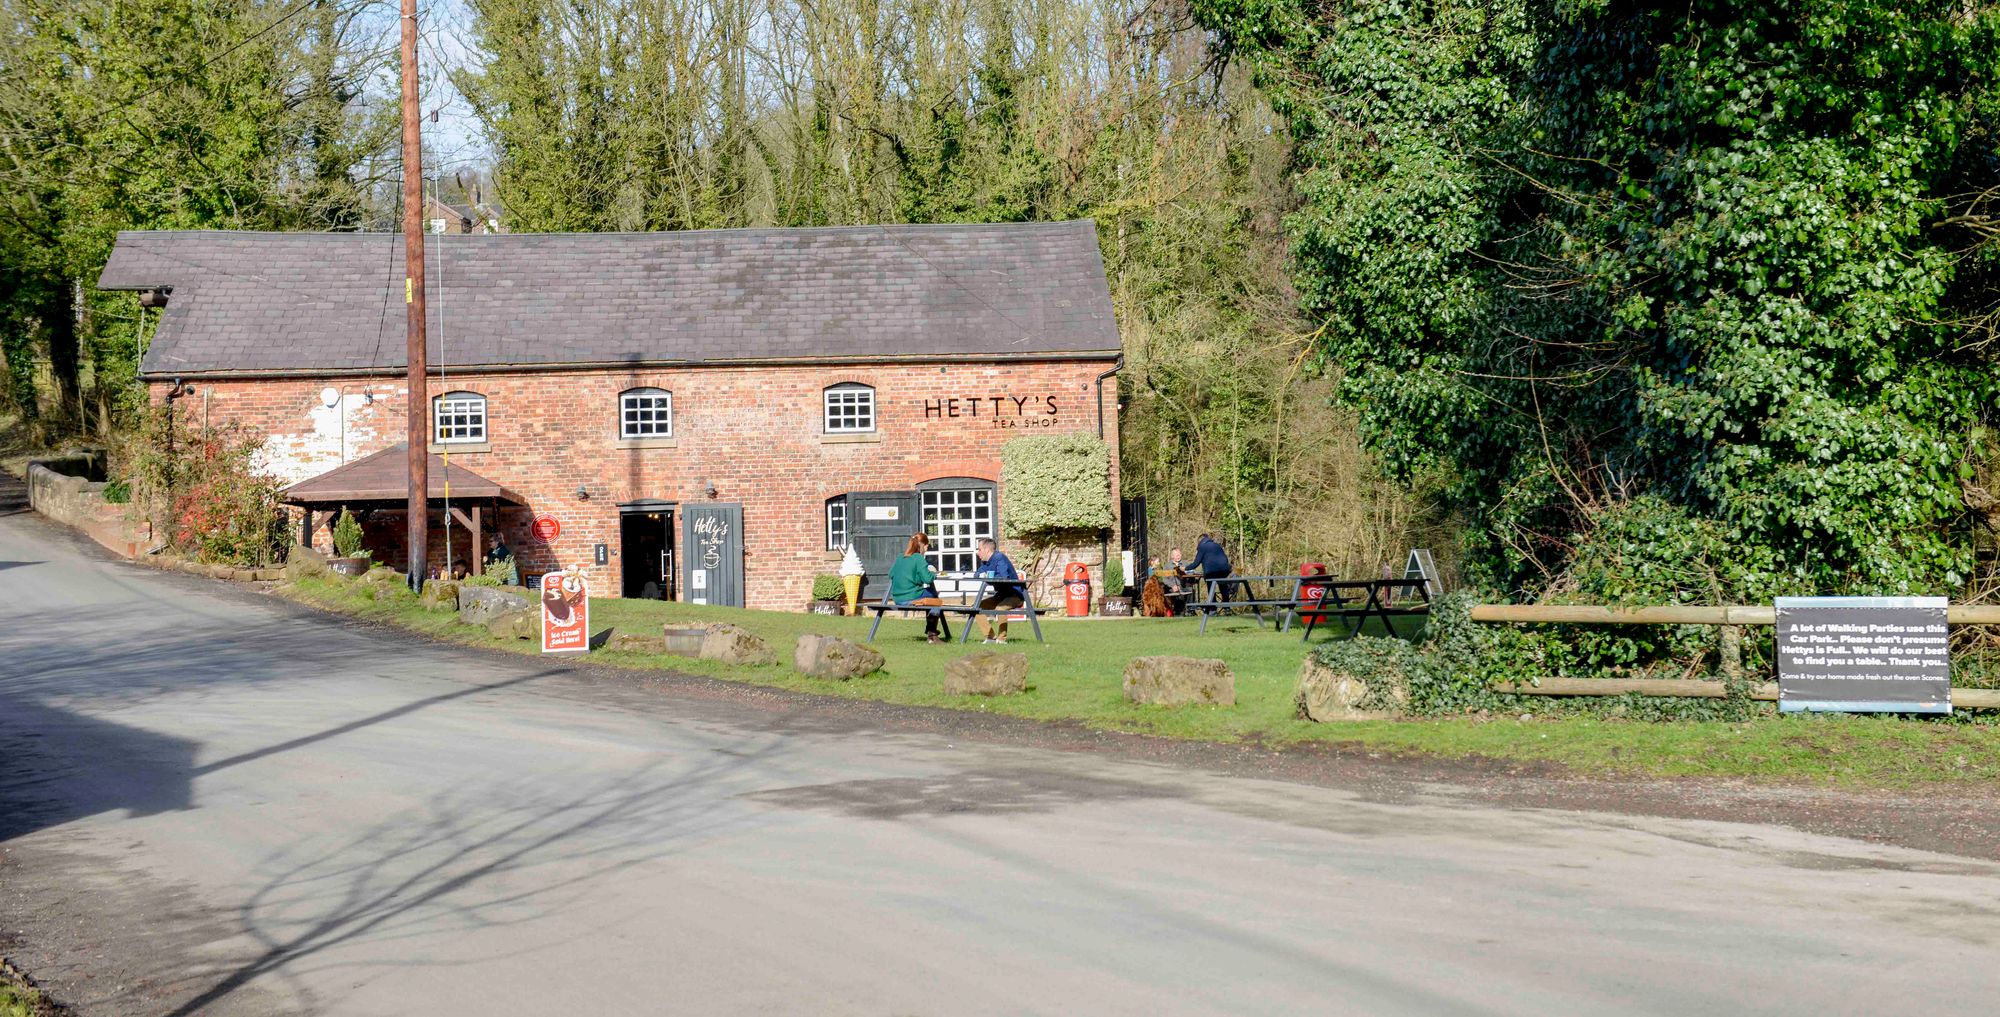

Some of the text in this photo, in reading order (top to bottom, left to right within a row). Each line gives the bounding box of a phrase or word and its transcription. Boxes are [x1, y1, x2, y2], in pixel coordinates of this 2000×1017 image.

[925, 395, 1058, 418] HETTY'S
[992, 418, 1058, 429] TEA SHOP
[694, 516, 728, 537] Hetty's
[1105, 601, 1127, 614] Hetty's
[1790, 624, 1799, 632] A
[1800, 624, 1814, 632] lot
[1815, 624, 1826, 632] of
[1828, 624, 1868, 634] Walking
[1869, 624, 1905, 633] Parties
[1926, 625, 1946, 633] this
[1790, 635, 1808, 643] Car
[1840, 635, 1873, 643] Please
[1874, 635, 1901, 643] don't
[1902, 637, 1947, 645] presume
[1781, 646, 1814, 655] Hettys
[1815, 646, 1825, 654] is
[1852, 646, 1869, 654] We
[1870, 646, 1889, 654] will
[1890, 647, 1904, 655] do
[1924, 647, 1947, 655] best
[1792, 657, 1804, 665] to
[1805, 656, 1826, 665] find
[1826, 658, 1846, 667] you
[1888, 657, 1921, 666] Thank
